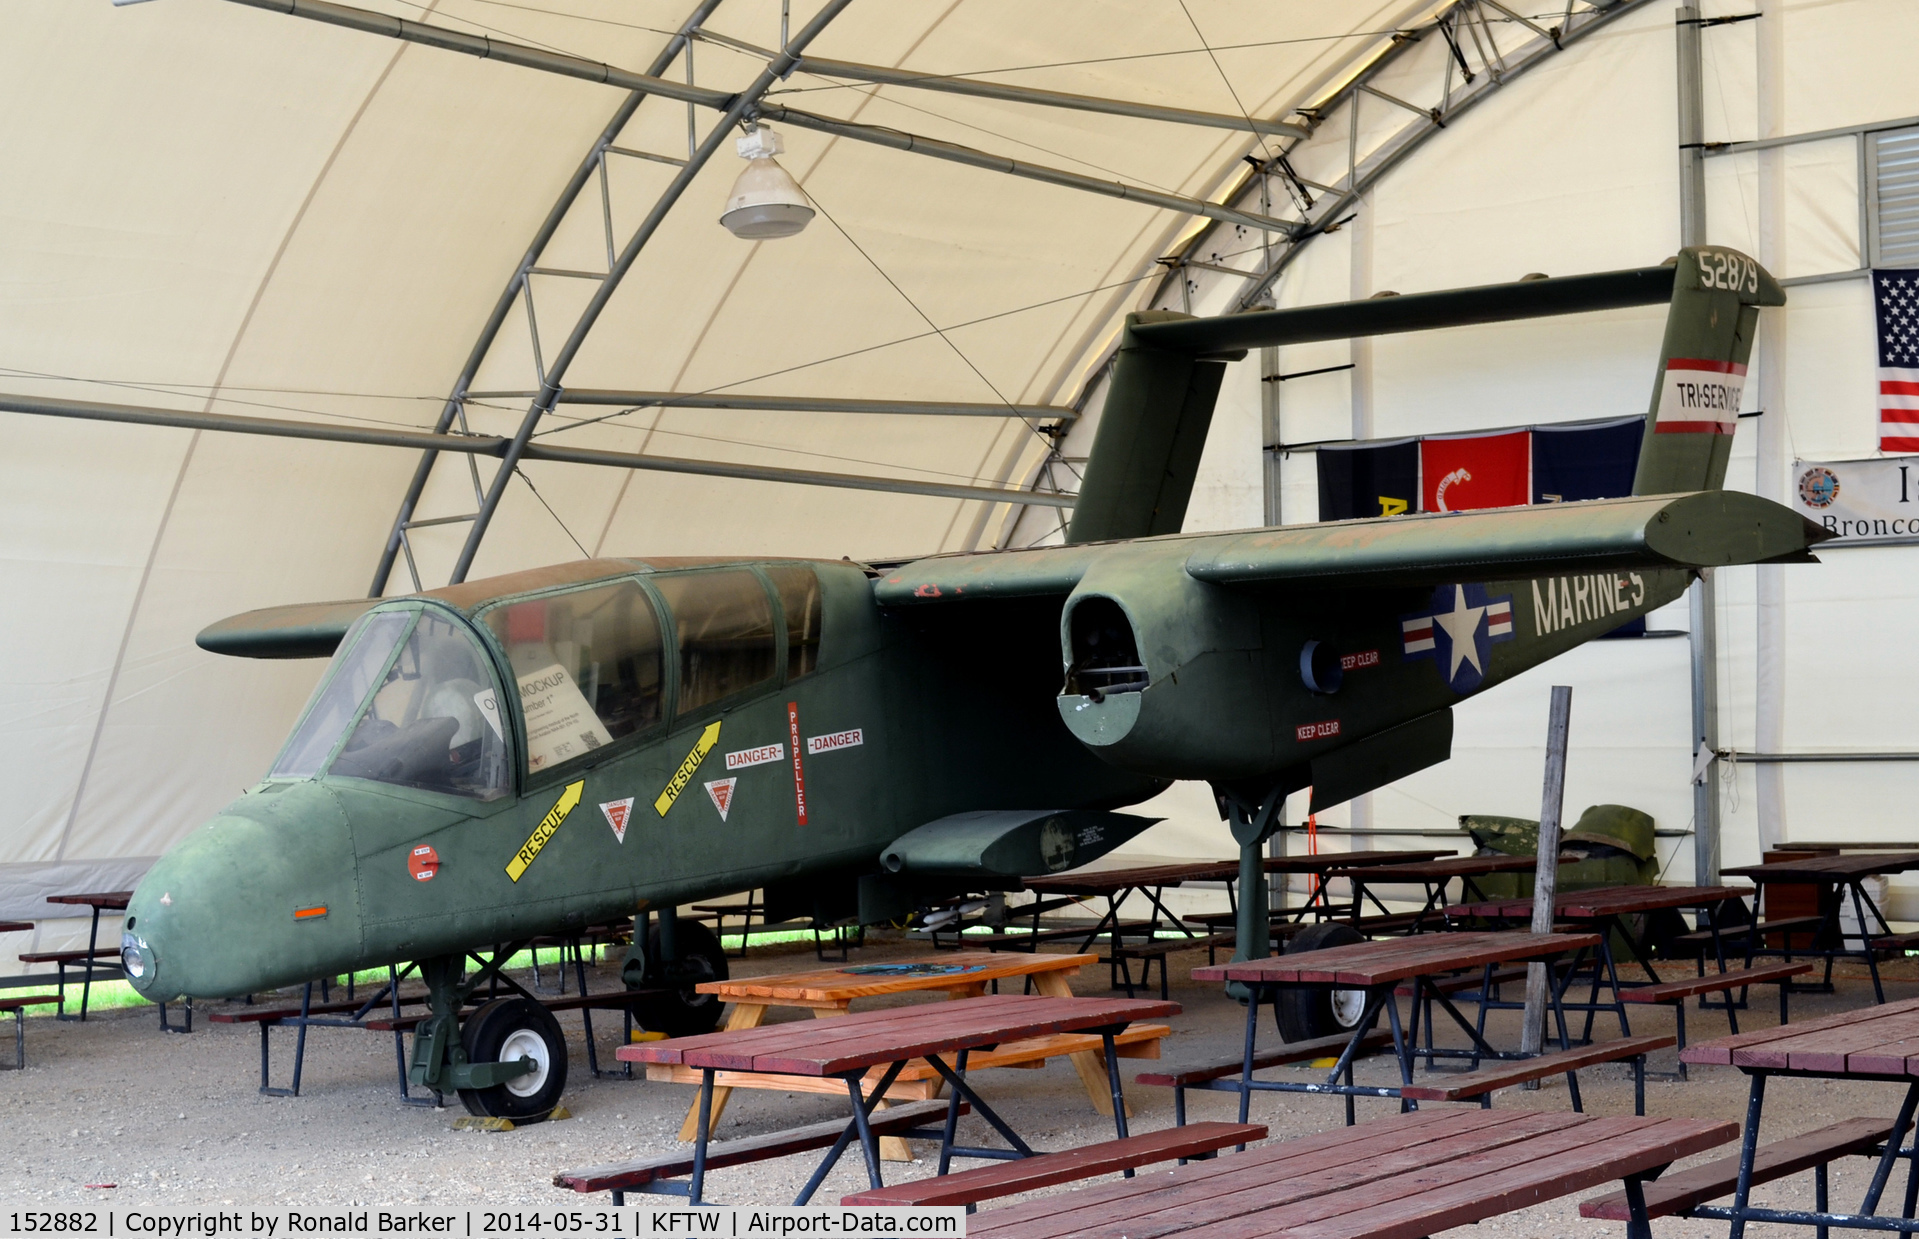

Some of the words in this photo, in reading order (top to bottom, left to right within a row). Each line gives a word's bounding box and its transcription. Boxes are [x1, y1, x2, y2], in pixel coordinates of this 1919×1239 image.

[1698, 251, 1758, 294] 52879
[1677, 383, 1741, 412] TRI-SERVICE
[1898, 466, 1919, 503] I
[1532, 572, 1645, 637] MARINES
[1357, 651, 1379, 666] CLEAR
[1297, 725, 1316, 740] KEEP
[1317, 721, 1340, 737] CLEAR
[665, 743, 706, 802] RESCUE
[790, 711, 805, 817] PROPELLER
[711, 779, 730, 787] DANGER
[607, 799, 627, 808] DANGER
[519, 803, 567, 866] RESCUE
